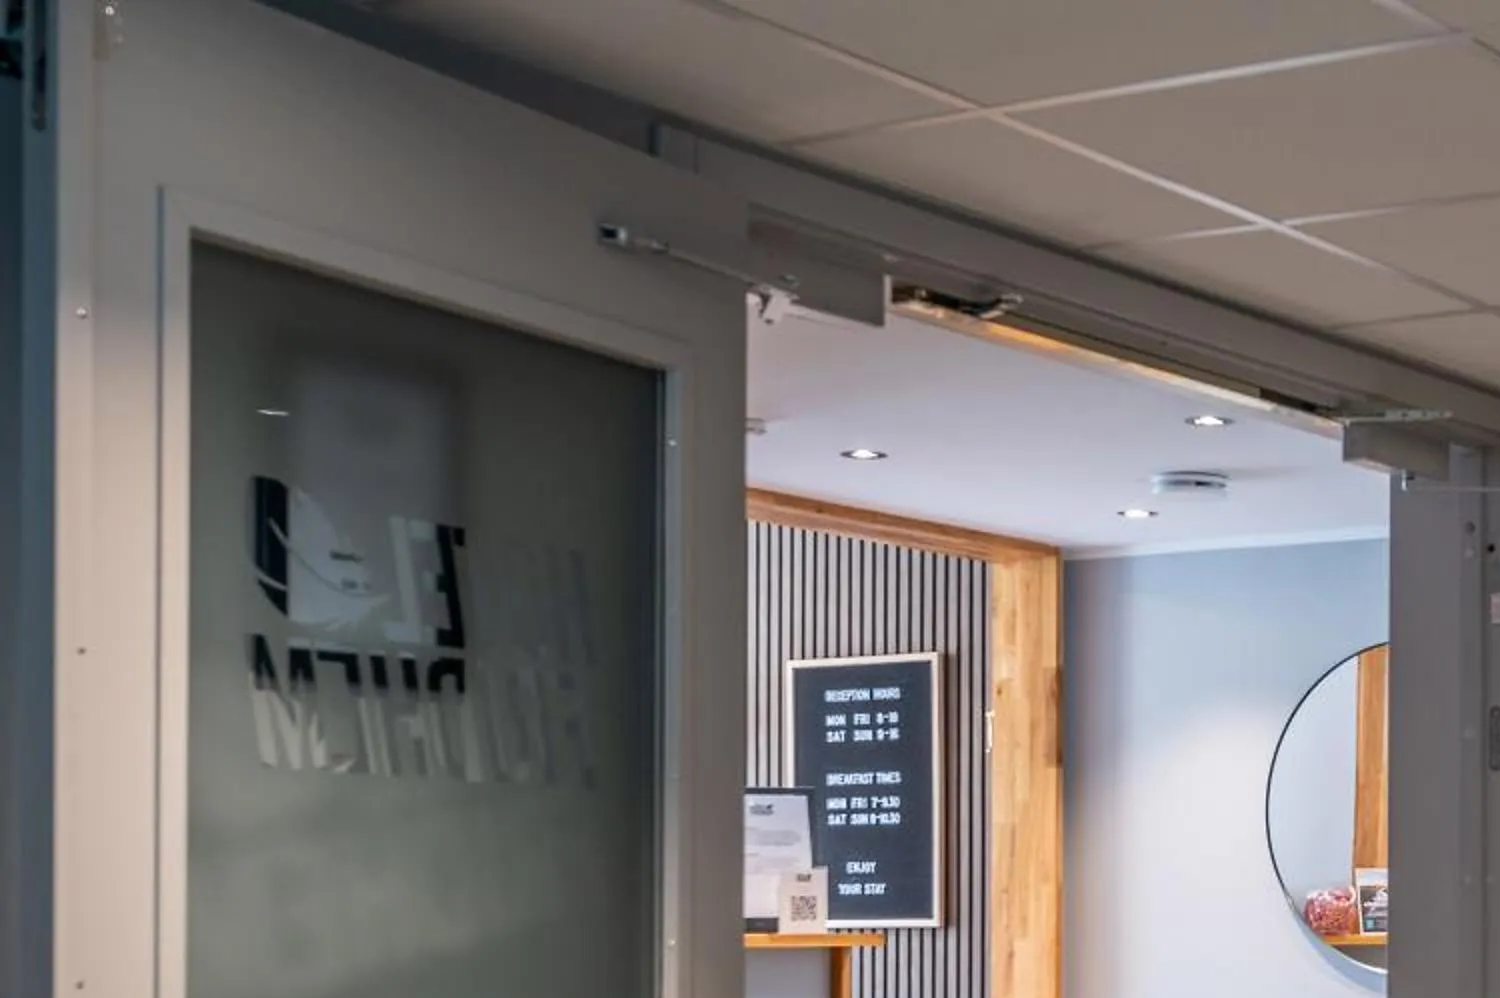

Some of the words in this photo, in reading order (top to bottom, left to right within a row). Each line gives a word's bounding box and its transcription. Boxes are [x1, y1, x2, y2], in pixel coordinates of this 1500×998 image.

[824, 687, 870, 703] RECEPTION
[873, 686, 902, 701] HOURS
[825, 713, 847, 727] MON
[853, 712, 871, 726] FRI
[825, 729, 846, 743] SAT
[853, 729, 873, 742] SUN
[825, 771, 875, 786] BREAKFAST
[875, 770, 902, 784] TIMES
[825, 797, 847, 811] MON
[850, 796, 868, 810] FRI
[827, 812, 848, 826] SAT
[850, 812, 869, 825] SUN
[846, 861, 877, 874] ENJOY
[838, 882, 863, 895] YOUR
[864, 882, 887, 895] STAY
